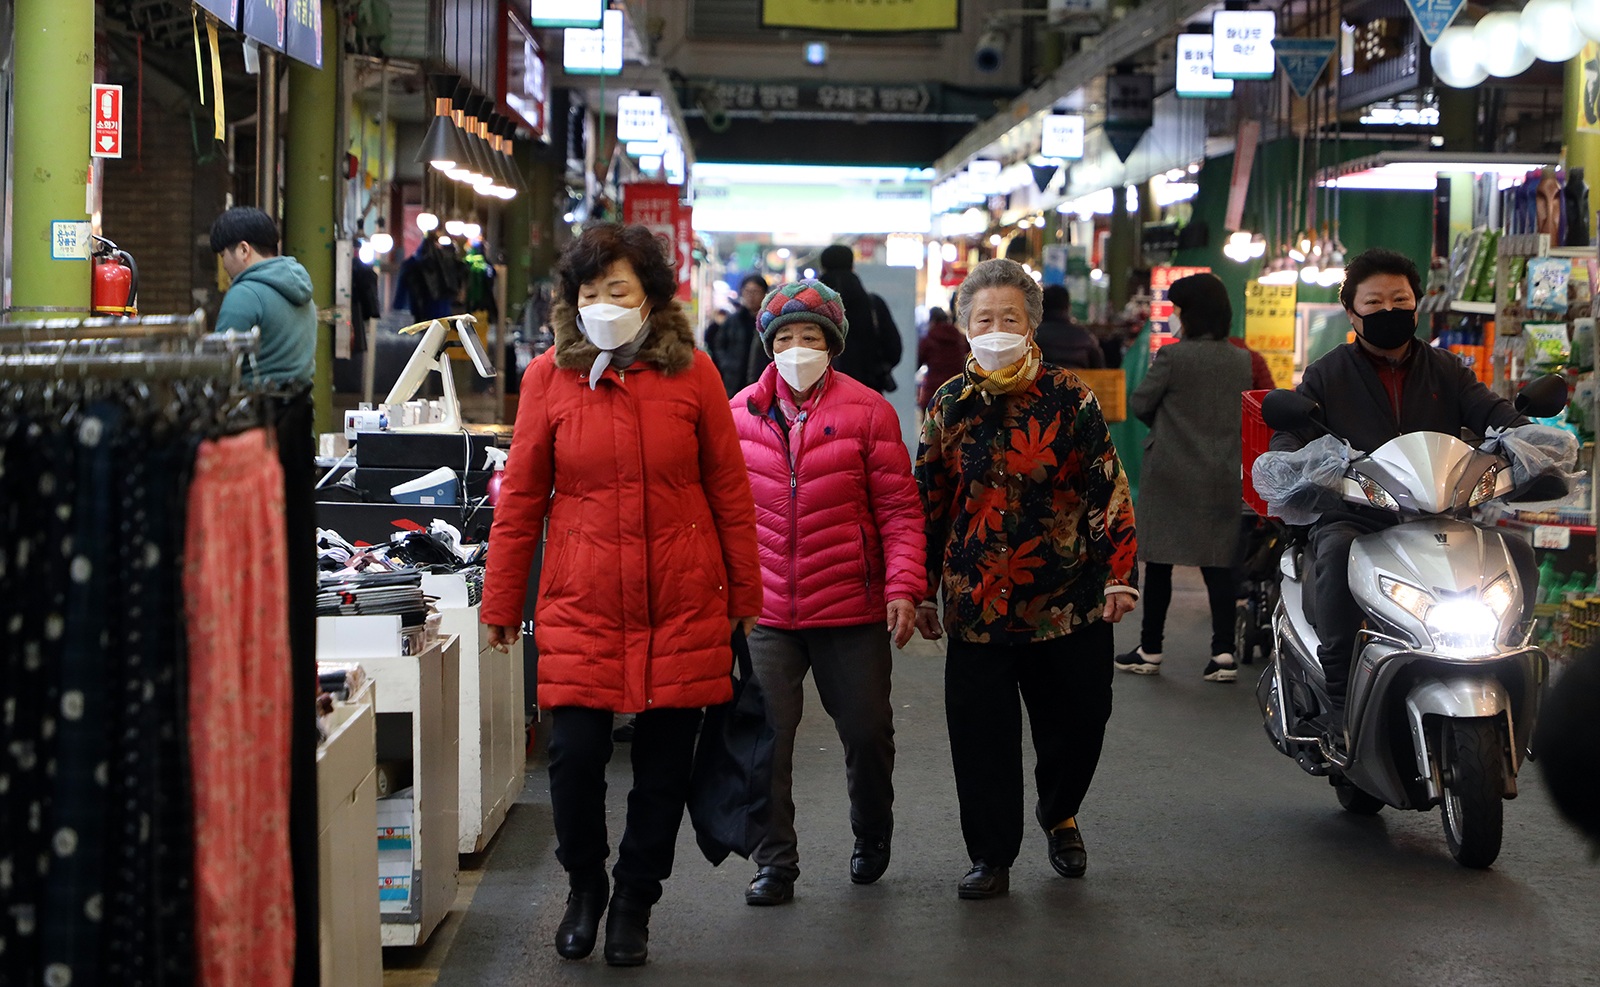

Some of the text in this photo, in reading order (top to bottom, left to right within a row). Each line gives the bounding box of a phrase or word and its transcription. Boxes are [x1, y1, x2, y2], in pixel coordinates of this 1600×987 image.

[1288, 56, 1317, 73] 카드
[816, 84, 875, 110] 우체국
[96, 120, 118, 130] 소화기
[56, 230, 77, 239] 온누리
[56, 238, 77, 247] 상품권
